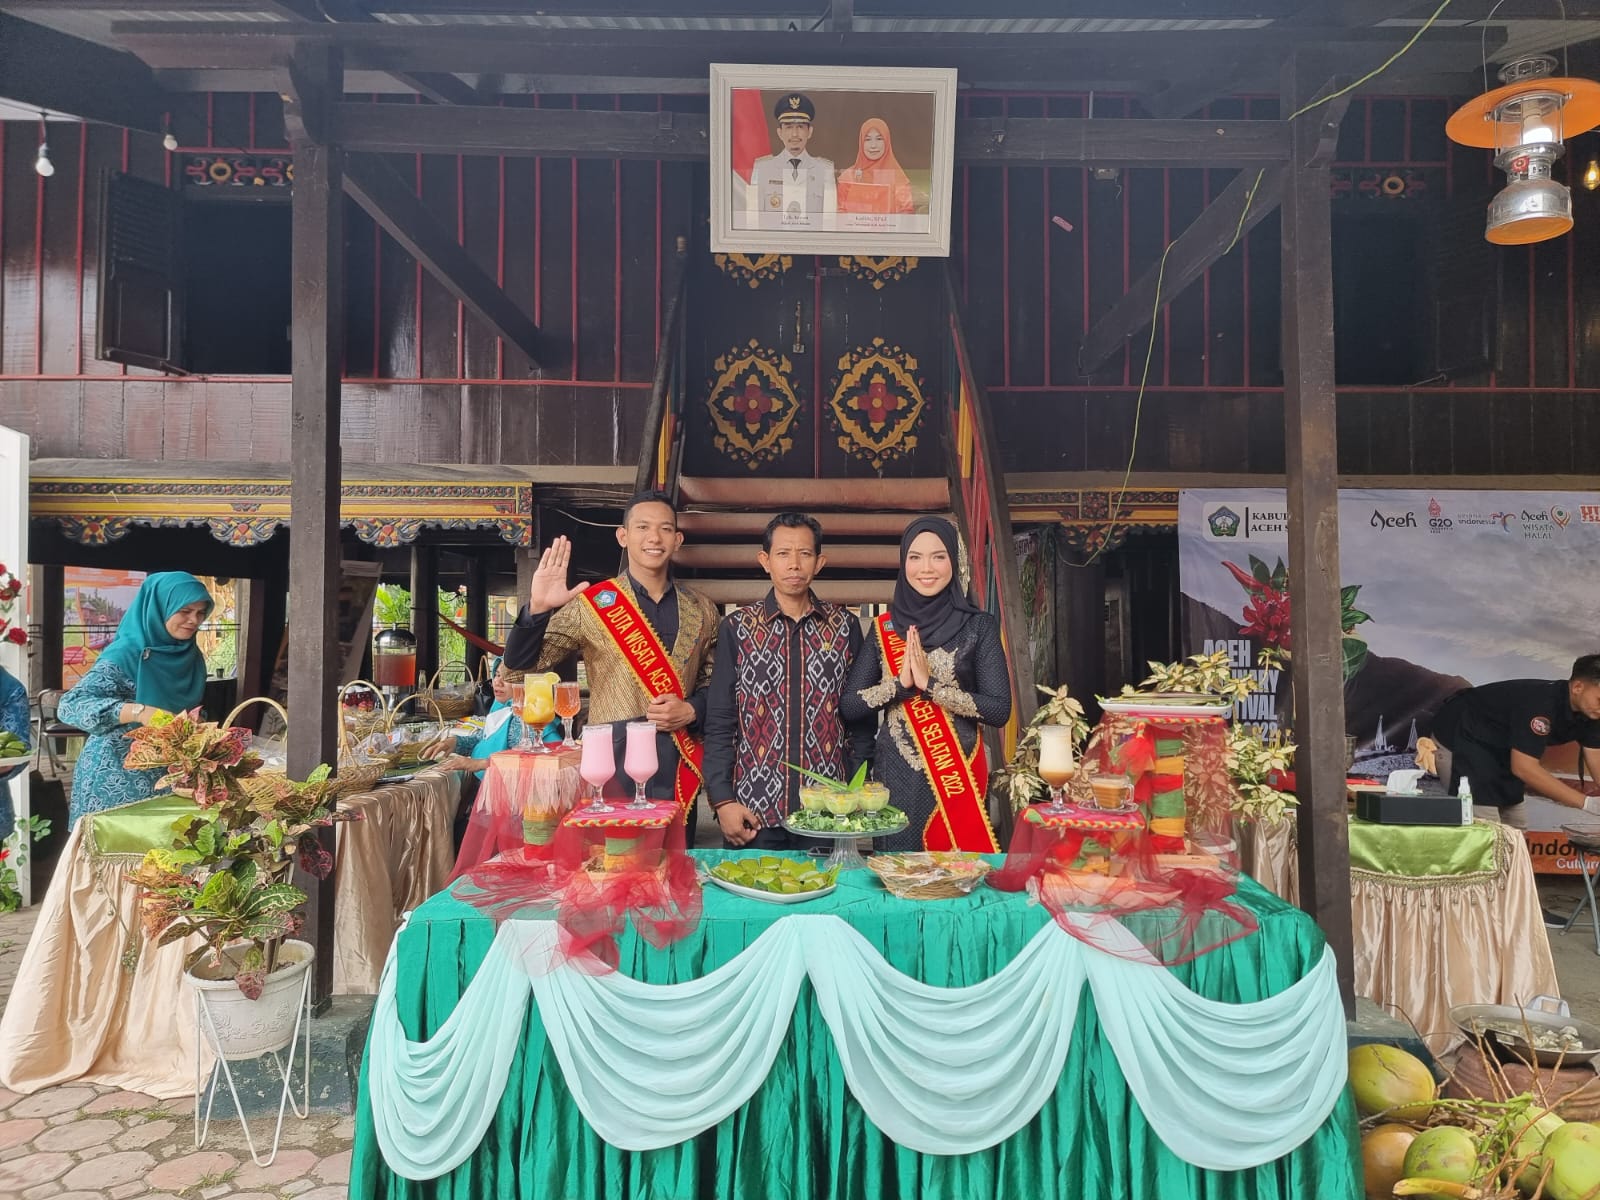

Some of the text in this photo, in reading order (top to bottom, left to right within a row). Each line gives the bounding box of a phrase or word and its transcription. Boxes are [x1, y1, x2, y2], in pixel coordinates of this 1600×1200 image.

[1370, 508, 1417, 532] Aceh
[1521, 509, 1549, 522] Aceh
[1250, 524, 1282, 532] ACEH
[1429, 518, 1453, 528] G20
[1523, 523, 1554, 531] WISATA
[1524, 532, 1553, 540] HALAL
[606, 605, 635, 635] DUTA
[623, 628, 658, 671] WISATA
[921, 722, 956, 771] SELATAN
[940, 770, 966, 799] 2022
